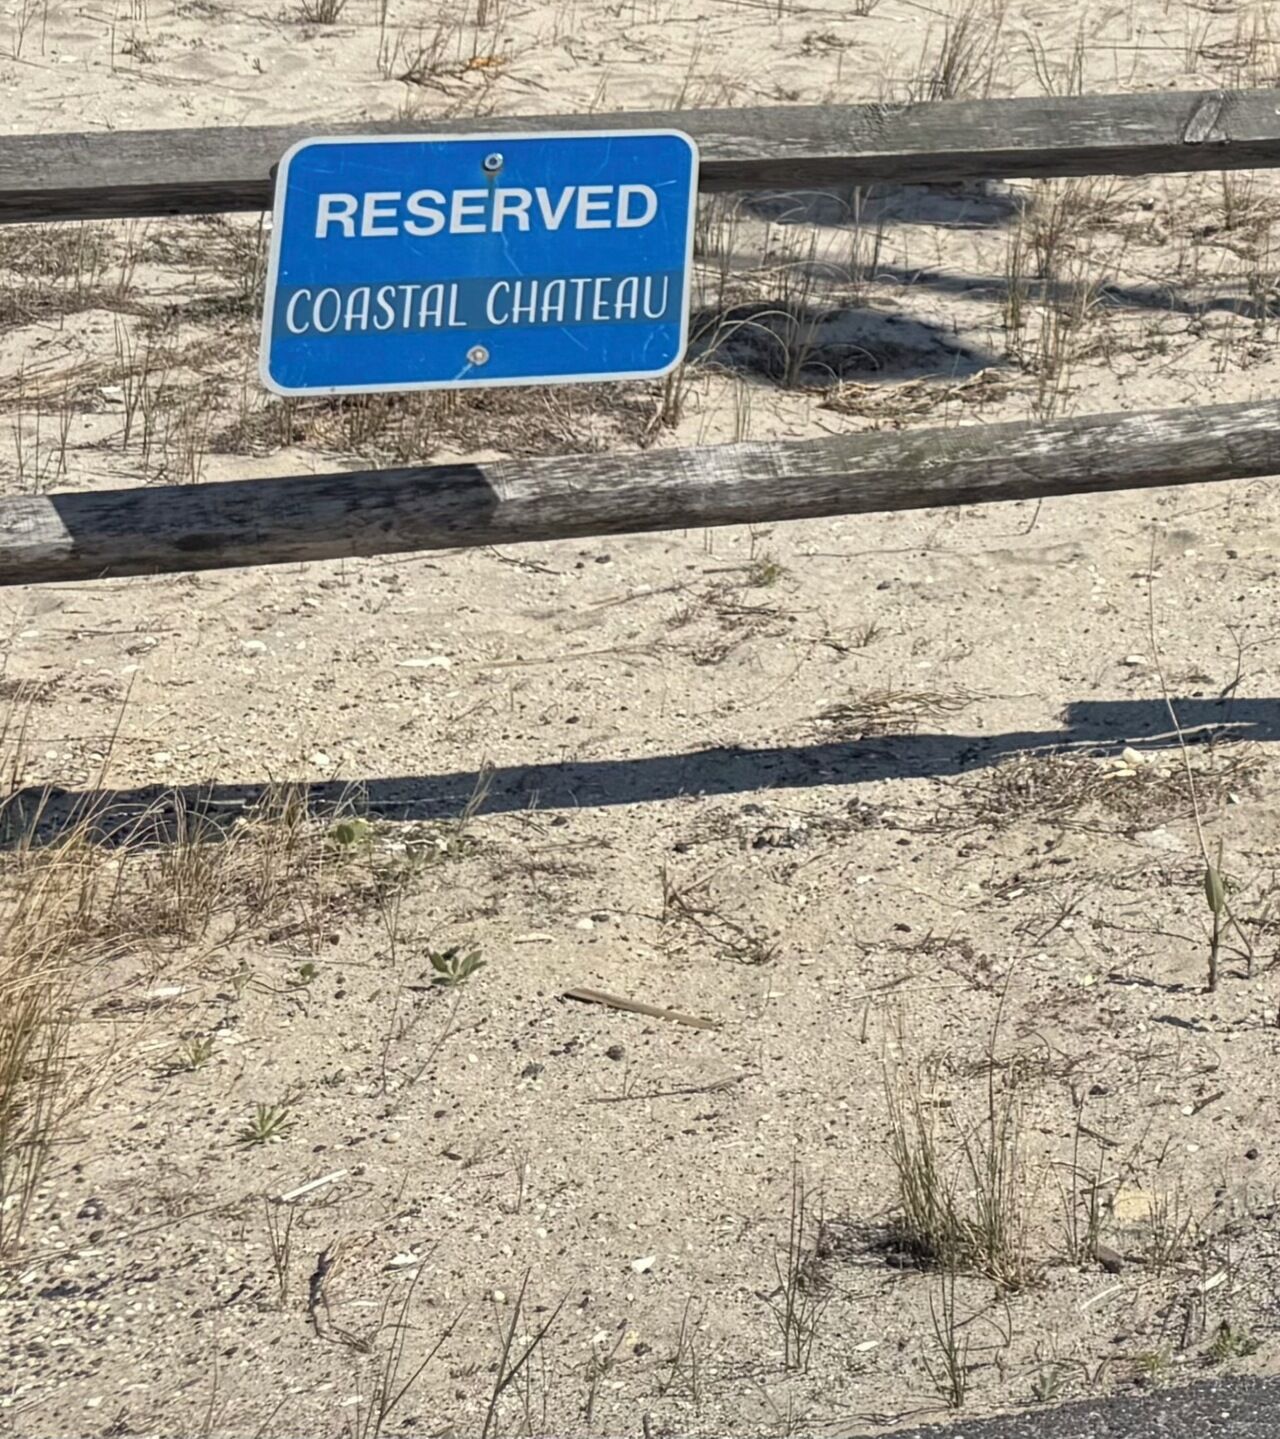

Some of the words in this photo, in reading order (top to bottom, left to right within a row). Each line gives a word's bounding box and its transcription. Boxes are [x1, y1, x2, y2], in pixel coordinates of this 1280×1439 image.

[315, 183, 659, 239] RESERVED
[286, 283, 468, 334] COASTAL
[485, 276, 669, 326] CHATEAU
